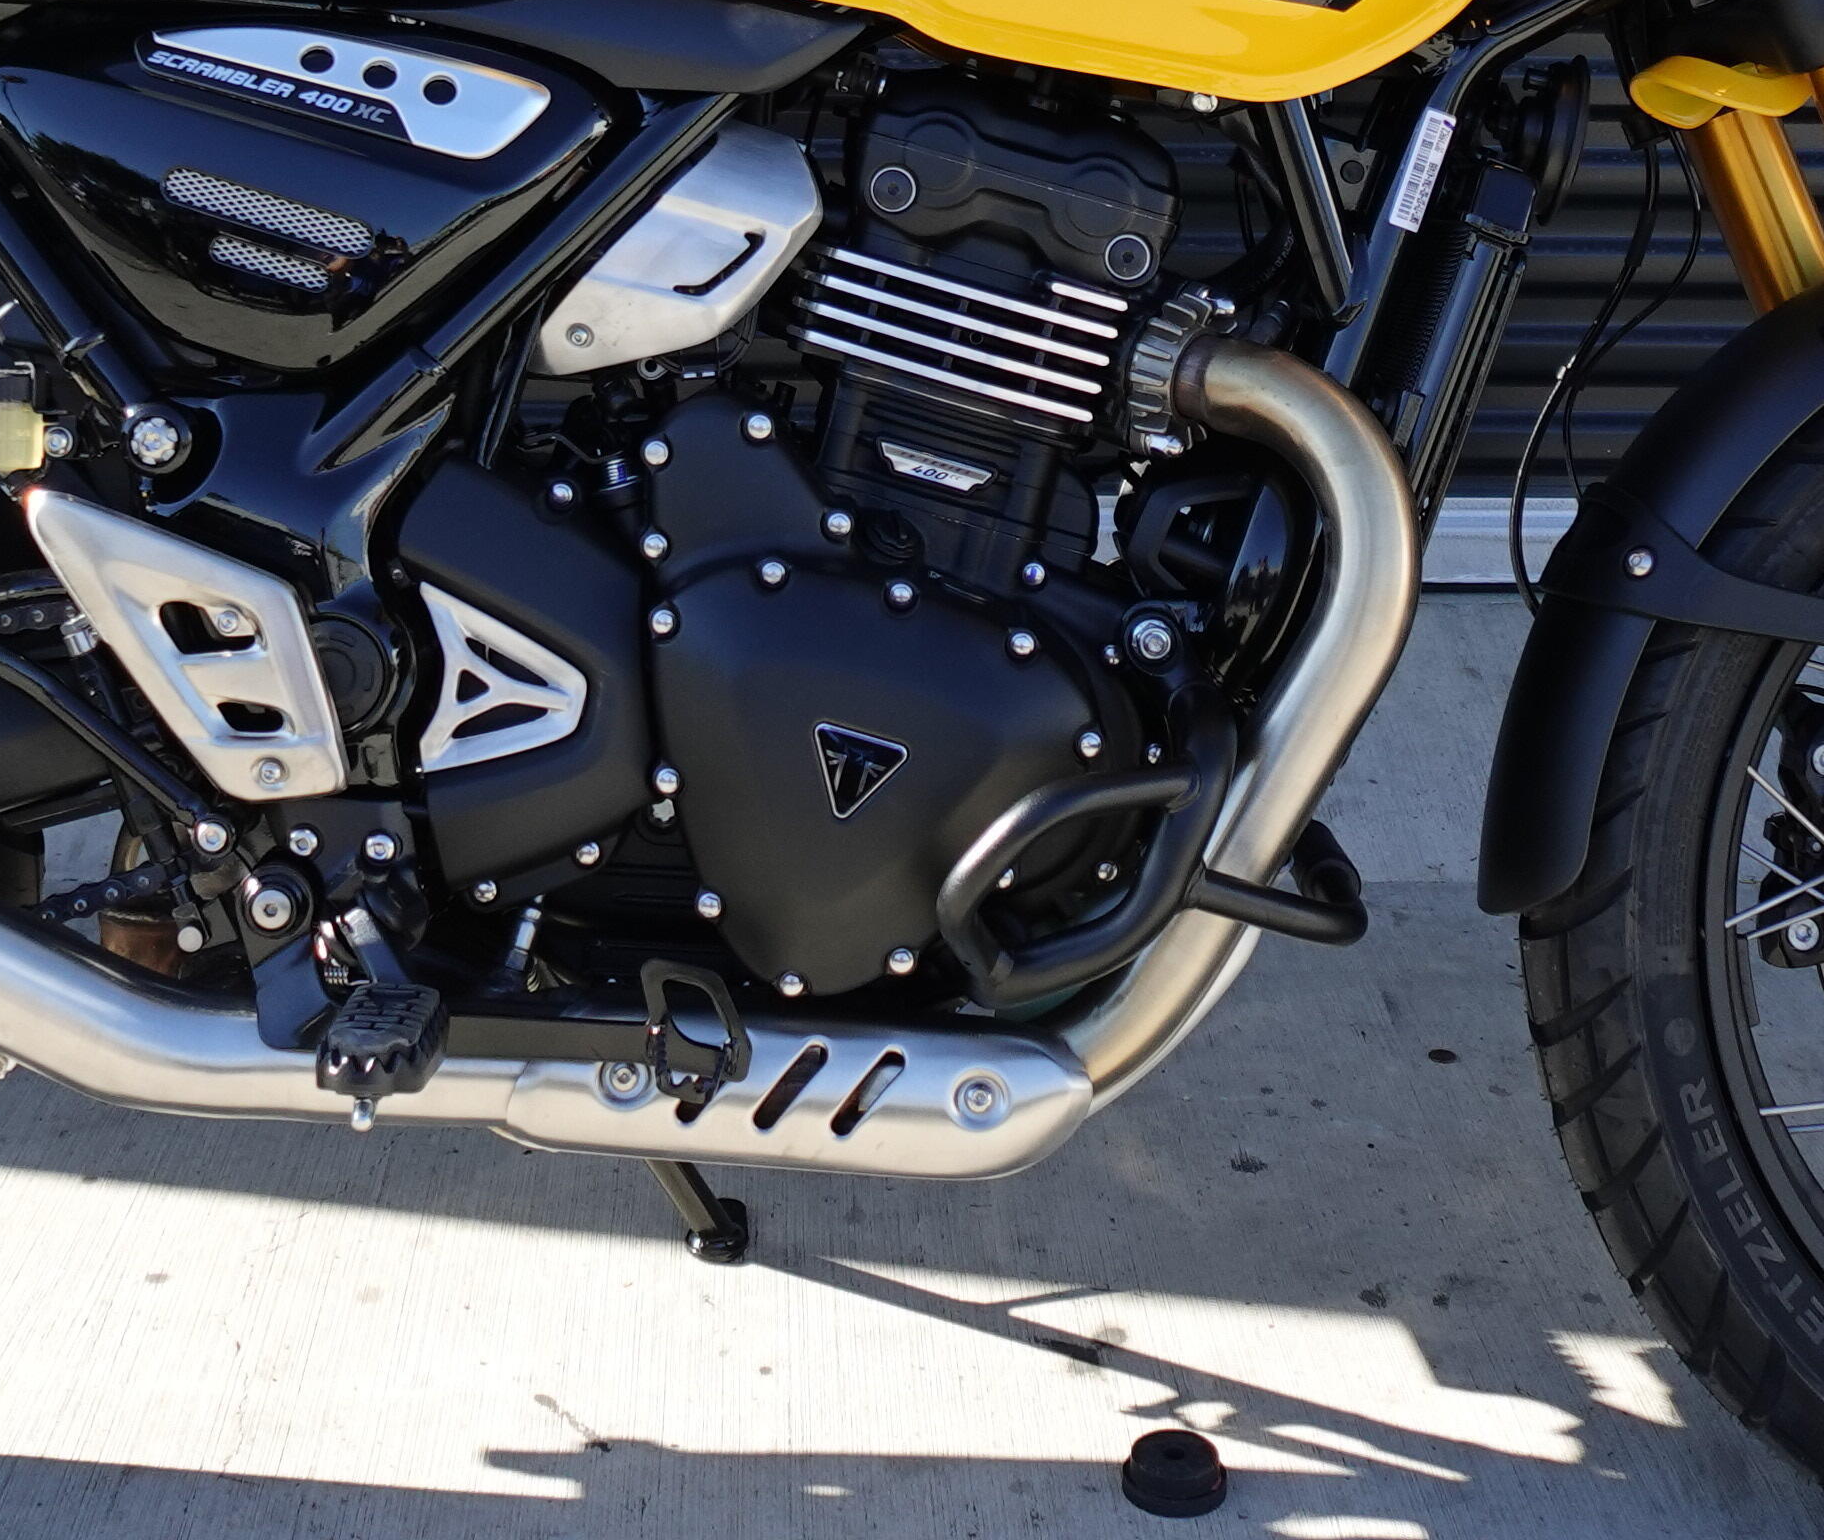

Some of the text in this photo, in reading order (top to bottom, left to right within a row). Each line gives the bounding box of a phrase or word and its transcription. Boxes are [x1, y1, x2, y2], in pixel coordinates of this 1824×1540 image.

[147, 50, 393, 124] SCRAMBLER 400 XC
